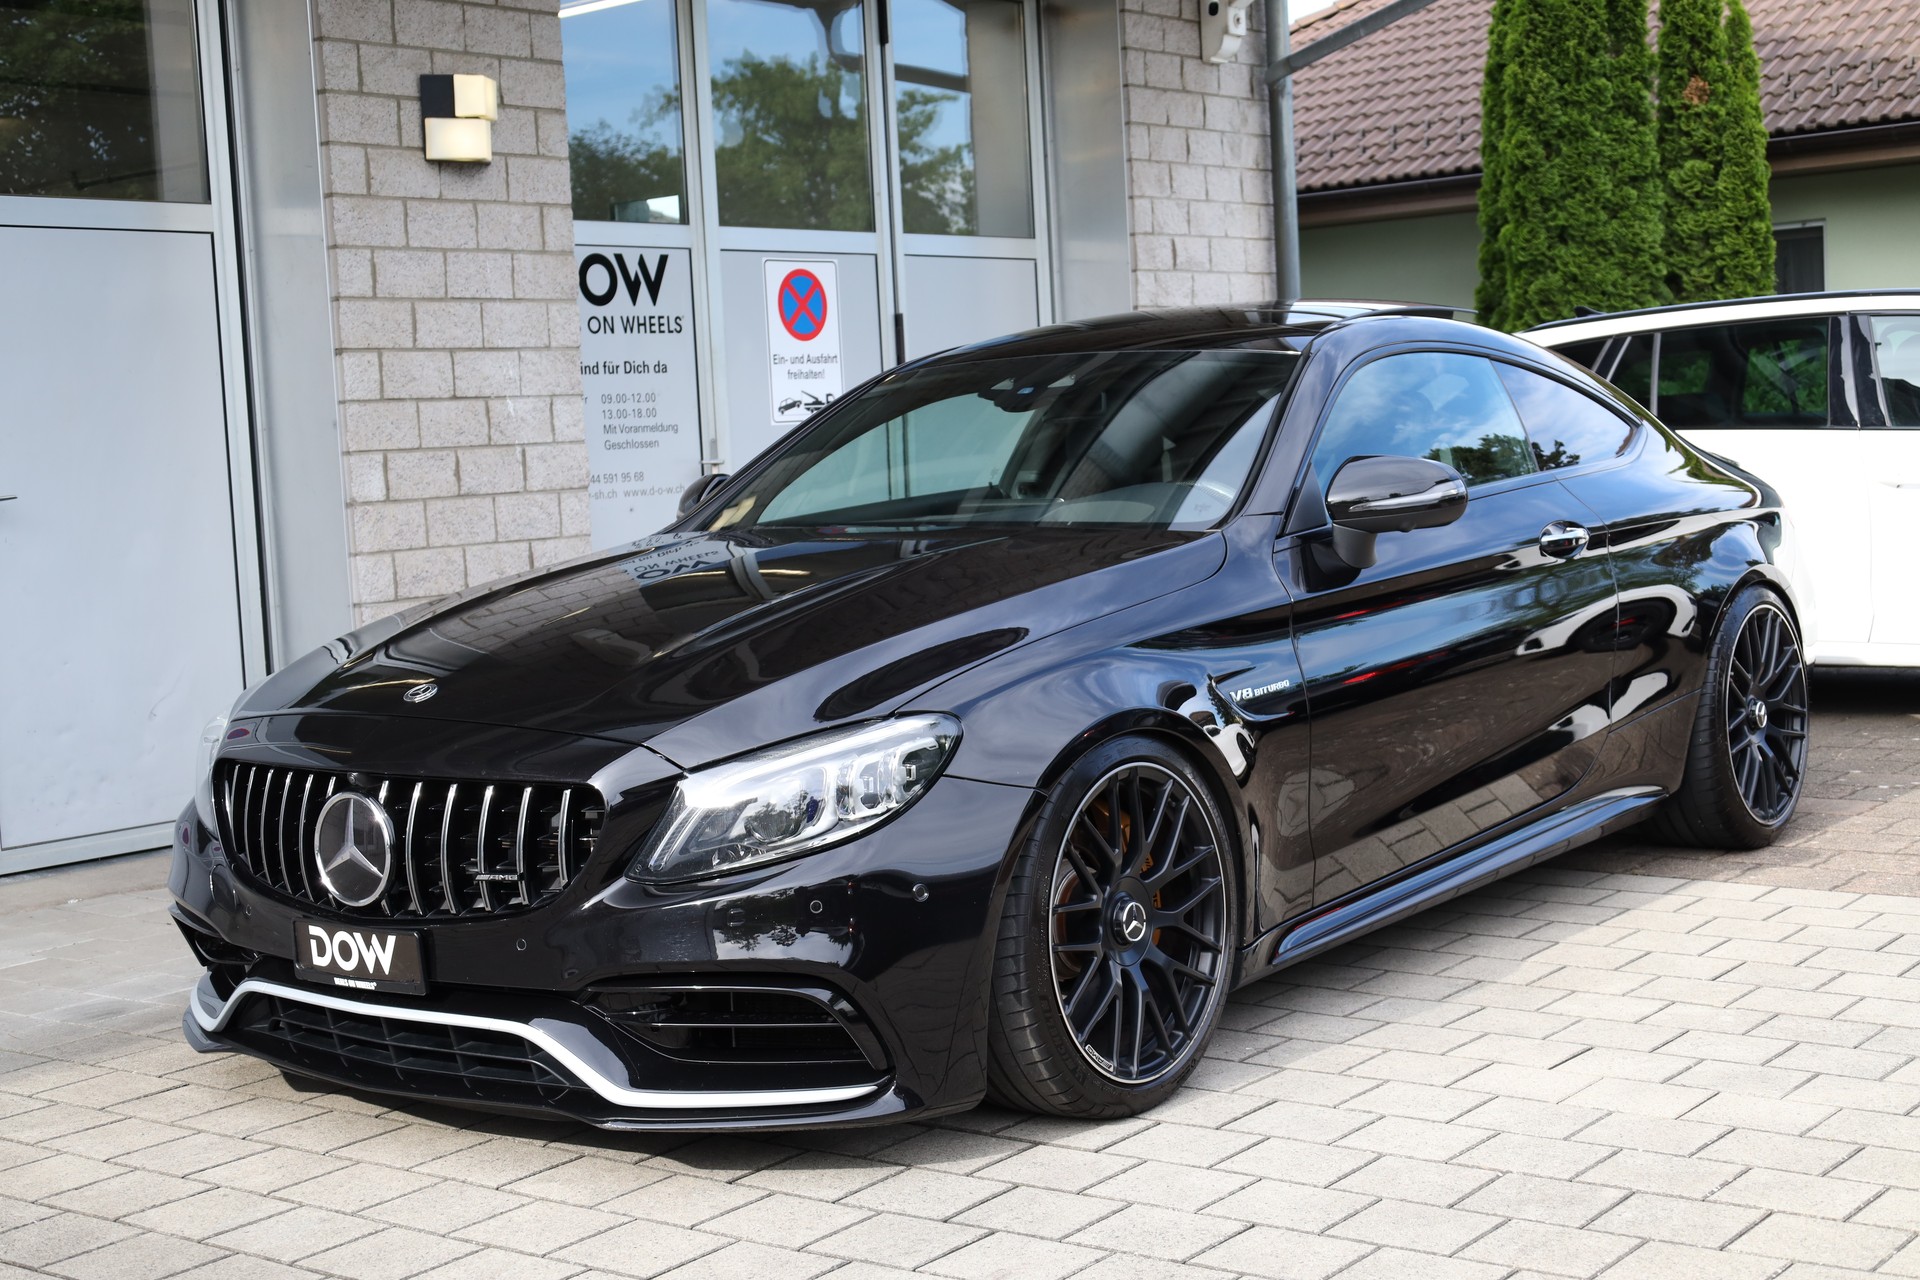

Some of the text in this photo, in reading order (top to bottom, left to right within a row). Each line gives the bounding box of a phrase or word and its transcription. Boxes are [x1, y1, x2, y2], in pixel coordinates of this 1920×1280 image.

[578, 253, 669, 307] OW
[587, 315, 683, 334] ON WHEELS
[773, 353, 838, 365] Ein- und Ausfahrt
[580, 360, 668, 375] ind für Dich da
[787, 369, 825, 380] freihalten!
[601, 393, 656, 404] 09.00-12.00
[602, 408, 657, 419] 13.00-18.00
[603, 423, 679, 434] Mit Voranmeldung
[604, 439, 660, 450] Geschlossen
[603, 473, 618, 484] 591
[621, 472, 632, 483] 95
[633, 471, 645, 482] 68
[623, 483, 685, 497] www.d-o-w.ch
[1229, 679, 1290, 703] V8 BITURBO
[308, 924, 397, 976] DOW
